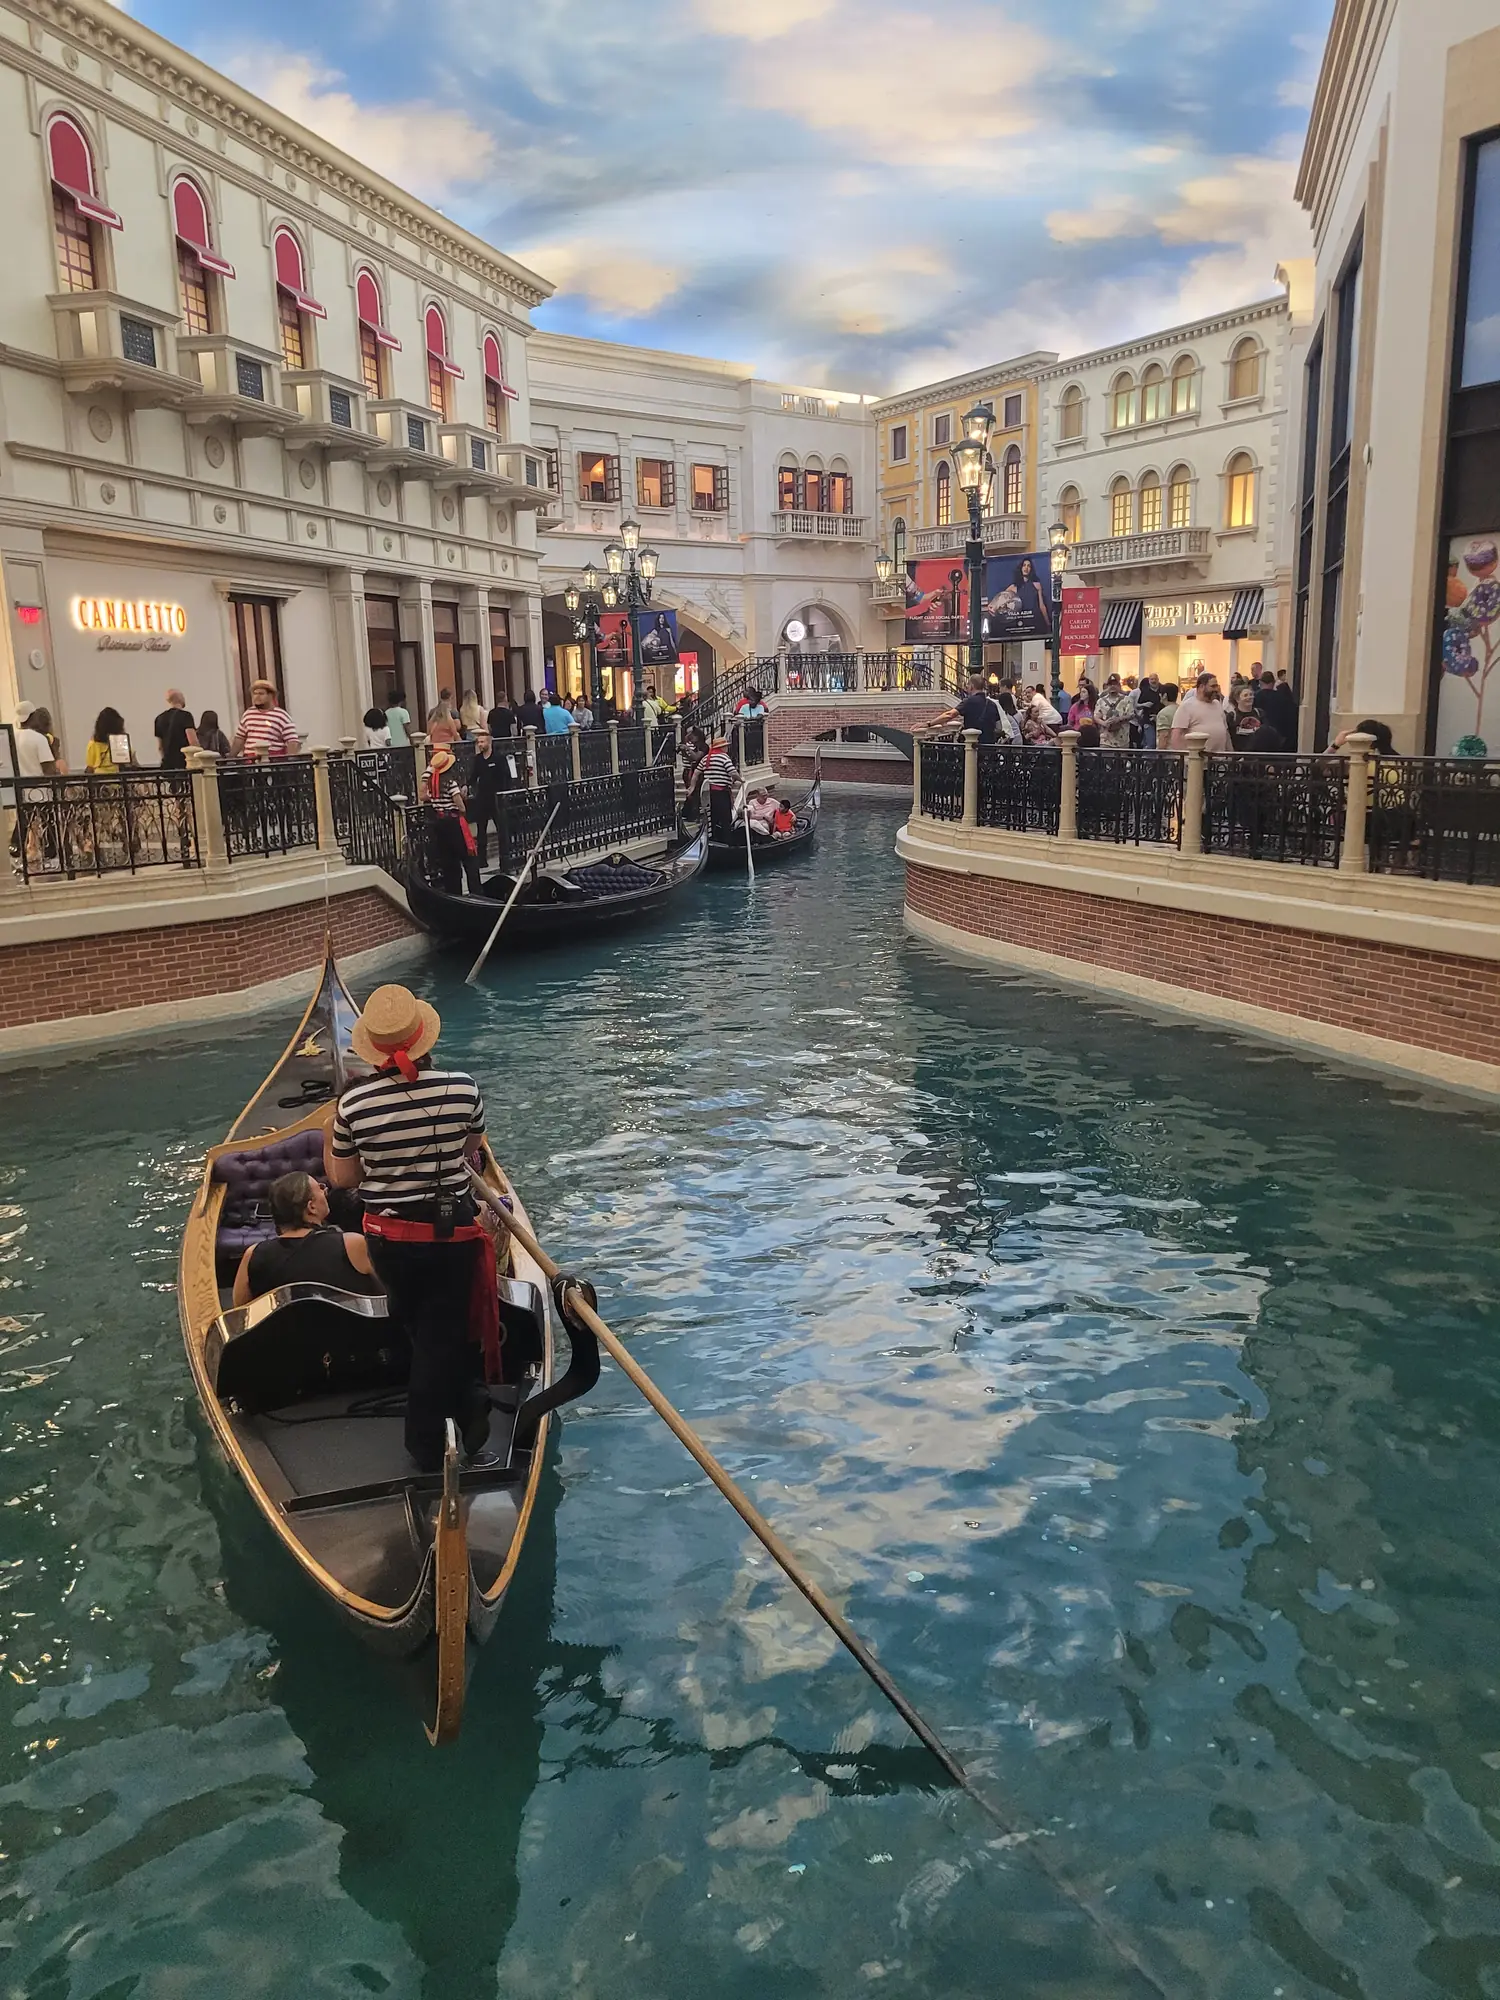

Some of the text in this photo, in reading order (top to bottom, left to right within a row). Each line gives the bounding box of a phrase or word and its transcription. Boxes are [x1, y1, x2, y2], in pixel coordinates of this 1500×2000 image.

[78, 599, 188, 634] CANALETTO
[1143, 600, 1232, 619] WHITE BLACK
[1148, 618, 1176, 628] HOUSE
[360, 759, 375, 768] EXIT
